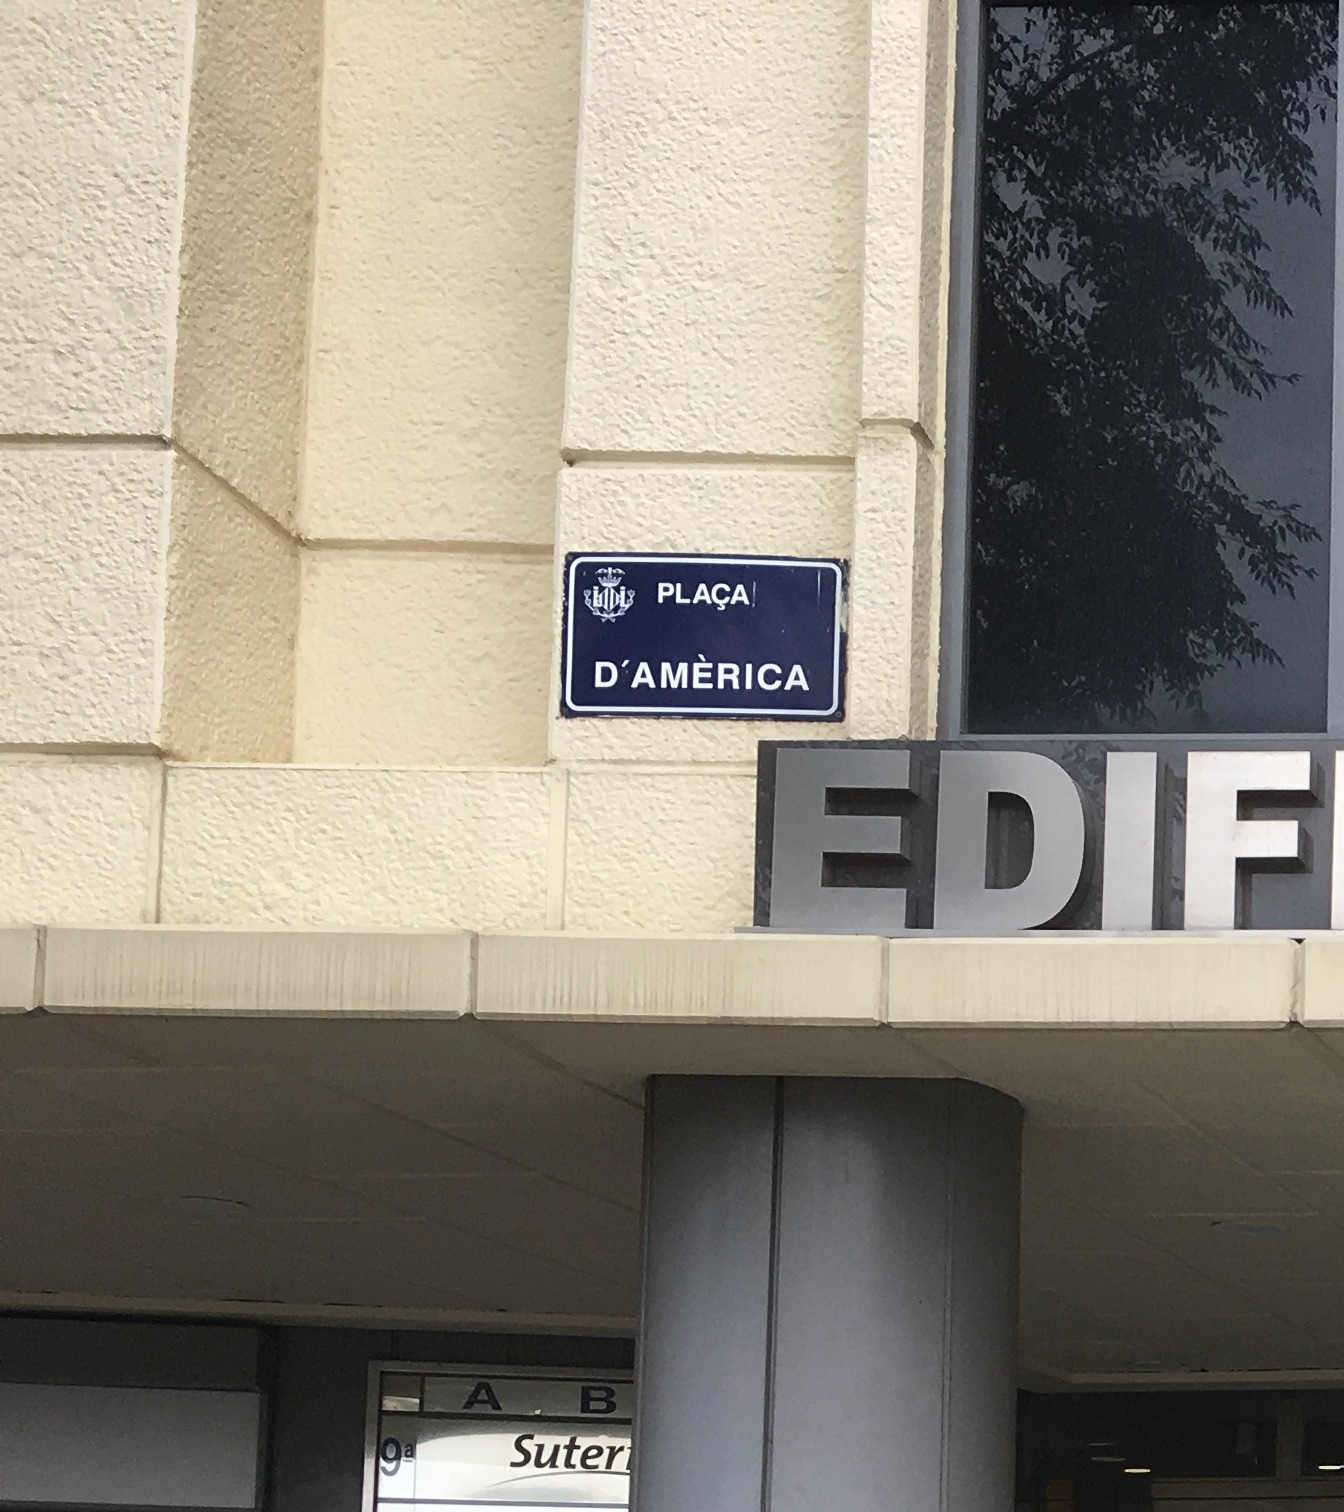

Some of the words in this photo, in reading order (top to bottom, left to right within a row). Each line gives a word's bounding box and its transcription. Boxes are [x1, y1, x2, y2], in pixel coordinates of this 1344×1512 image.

[657, 582, 750, 611] PLAÇA
[462, 1381, 503, 1411] A
[580, 1385, 617, 1415] B
